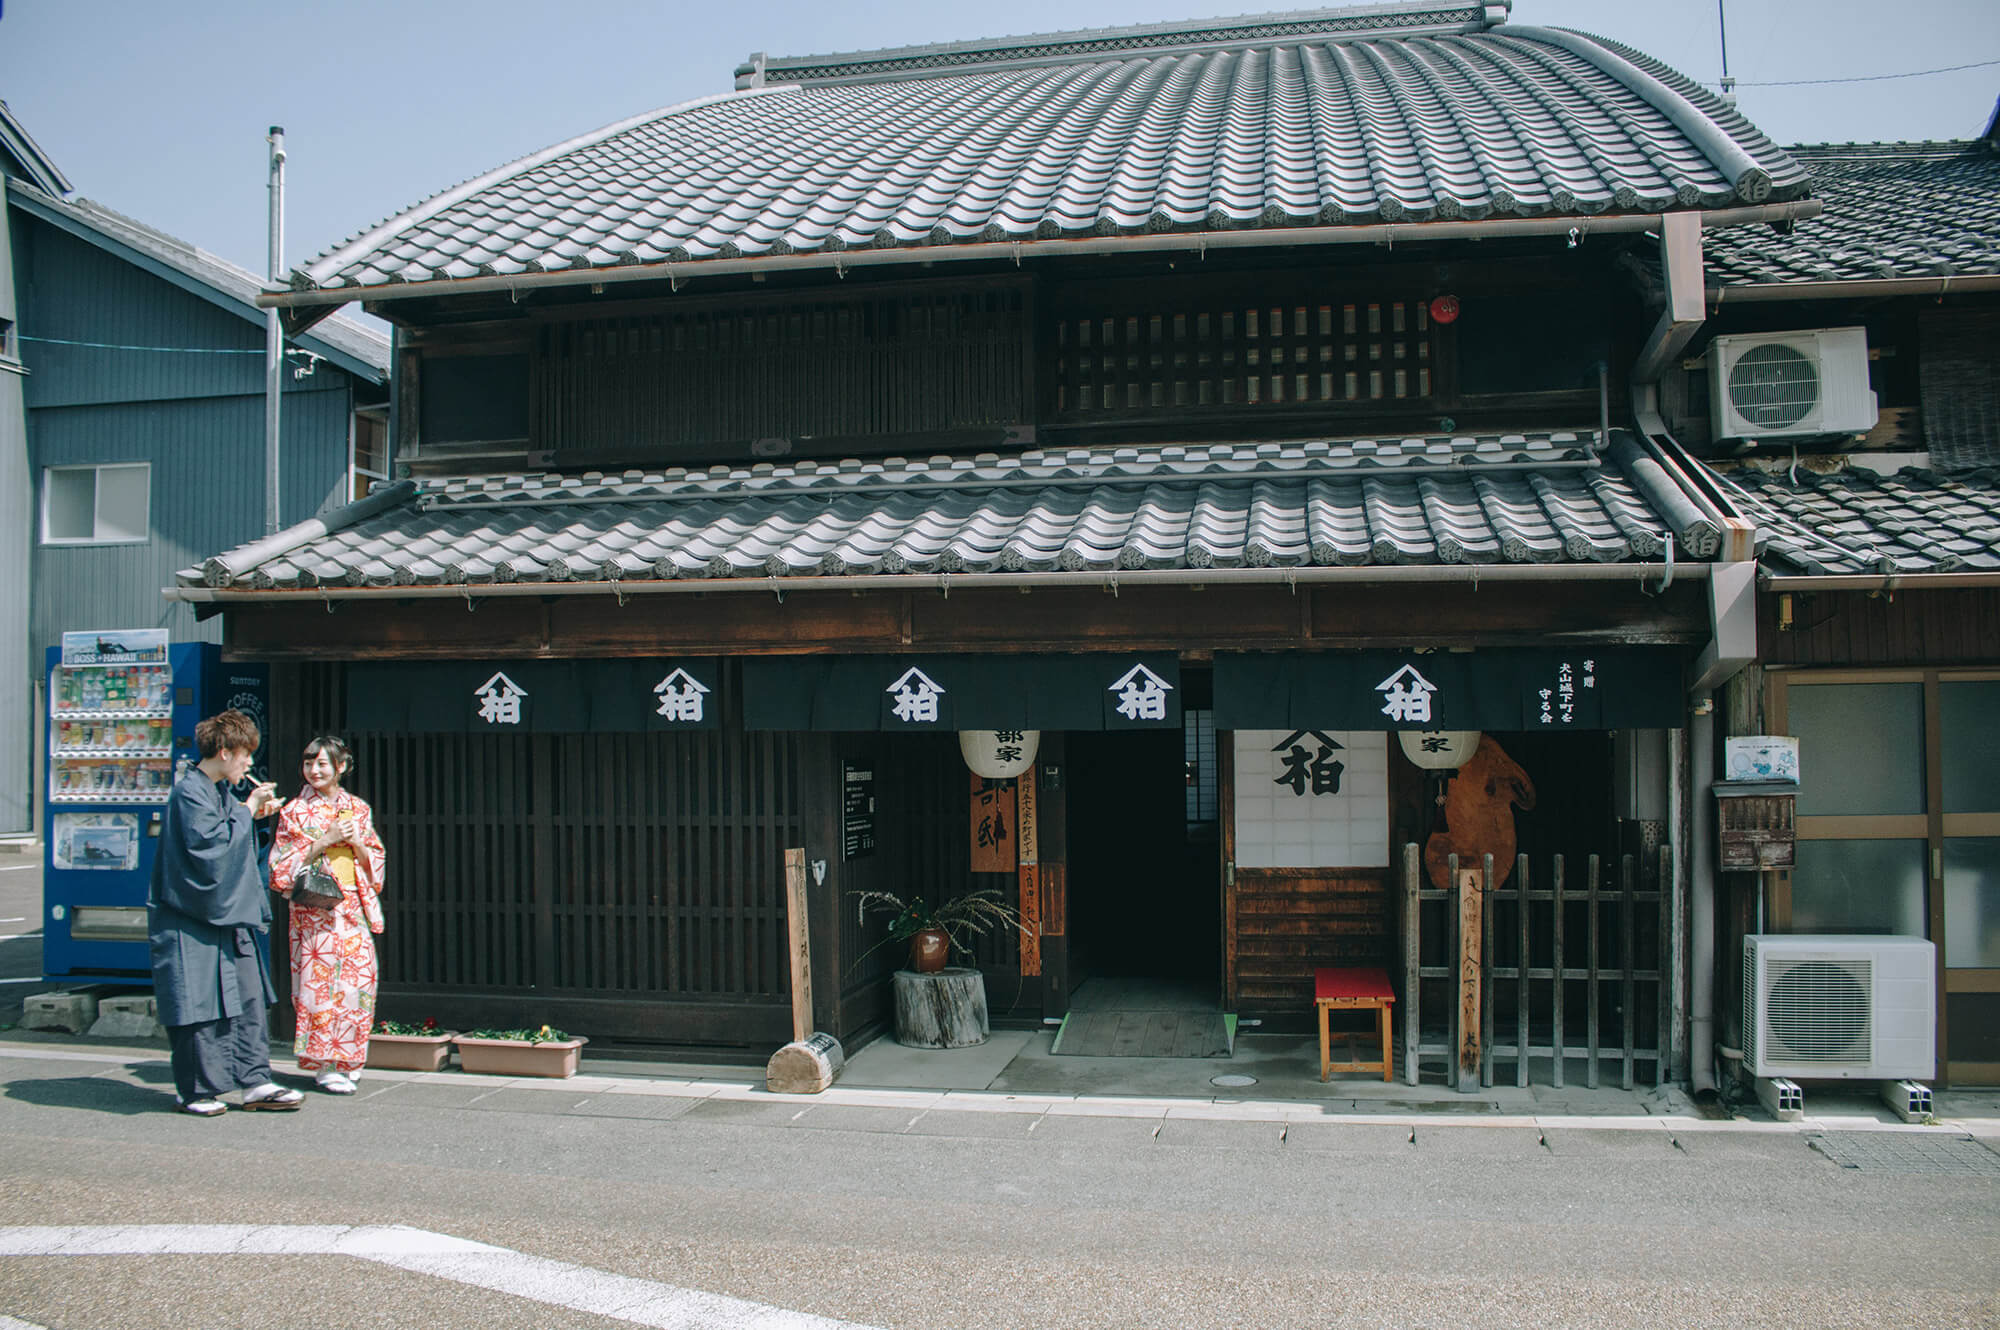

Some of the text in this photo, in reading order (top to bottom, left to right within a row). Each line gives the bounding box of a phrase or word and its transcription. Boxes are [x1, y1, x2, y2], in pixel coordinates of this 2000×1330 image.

[74, 653, 96, 664] BOSS
[103, 652, 136, 663] HAWAII
[1583, 660, 1595, 688] 寄贈
[230, 676, 260, 686] SUNTORY
[1559, 663, 1574, 723] 犬山城下町を
[227, 692, 264, 713] COFFEE
[479, 688, 522, 724] 柏
[656, 683, 704, 722] 柏
[893, 684, 938, 722] 柏
[1117, 682, 1165, 721] 柏
[1381, 683, 1432, 722] 柏
[1539, 688, 1553, 724] 守る会
[1273, 745, 1344, 796] 柏
